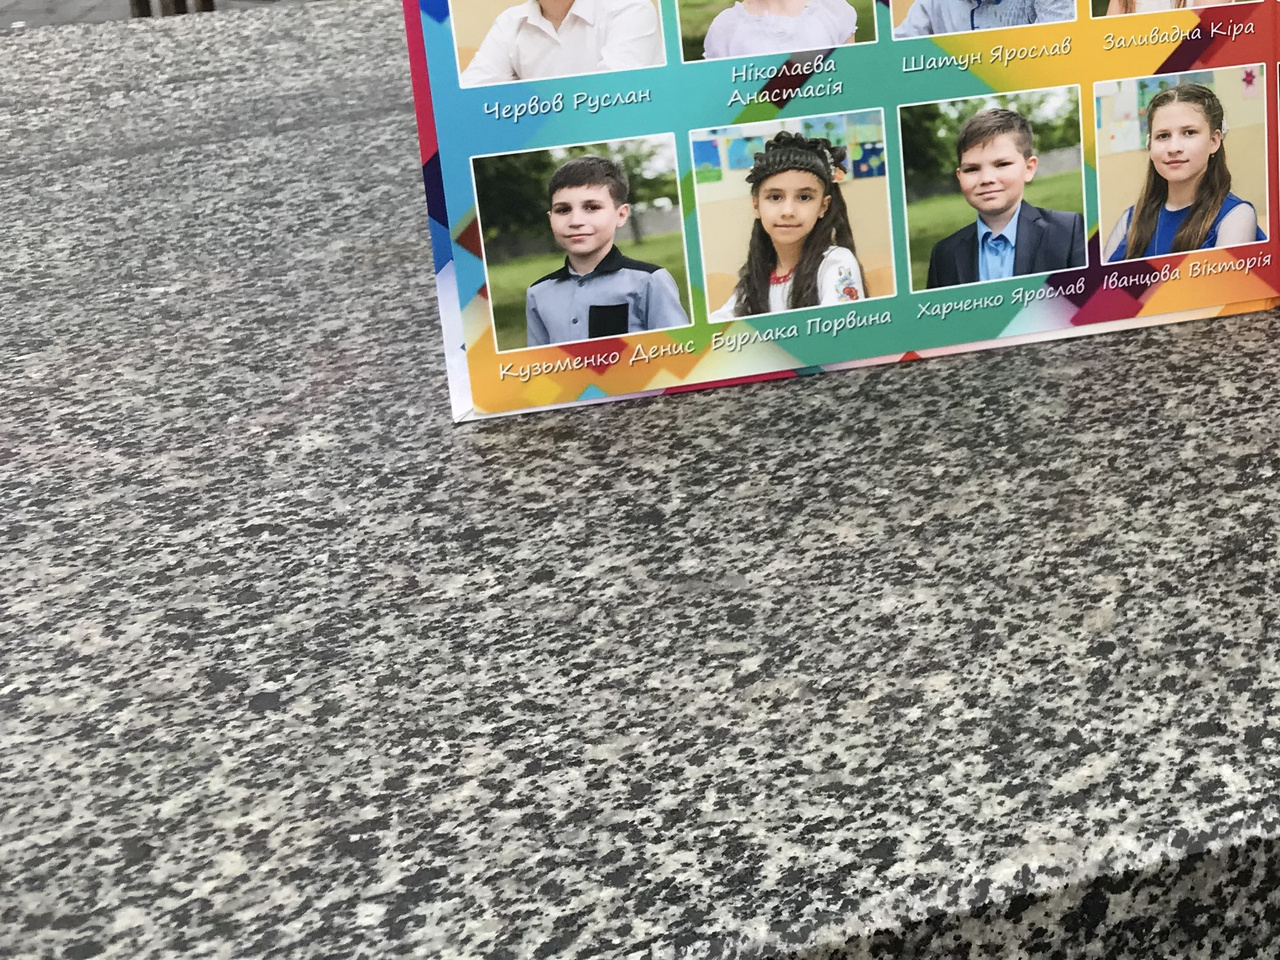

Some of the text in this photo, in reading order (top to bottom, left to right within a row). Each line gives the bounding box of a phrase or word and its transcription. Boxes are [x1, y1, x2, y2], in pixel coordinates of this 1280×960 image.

[1102, 19, 1256, 51] Заливадна Кіра
[731, 57, 836, 84] Ніколаєва
[902, 36, 1072, 73] Шатун Ярослав
[484, 88, 652, 124] Червов Руслан
[726, 78, 844, 108] Анастасія
[1102, 254, 1272, 291] Іванцова Вікторія
[917, 276, 1086, 319] Харченко Ярослав
[711, 324, 798, 352] Бурлака
[499, 339, 696, 382] Кузьменко Денис
